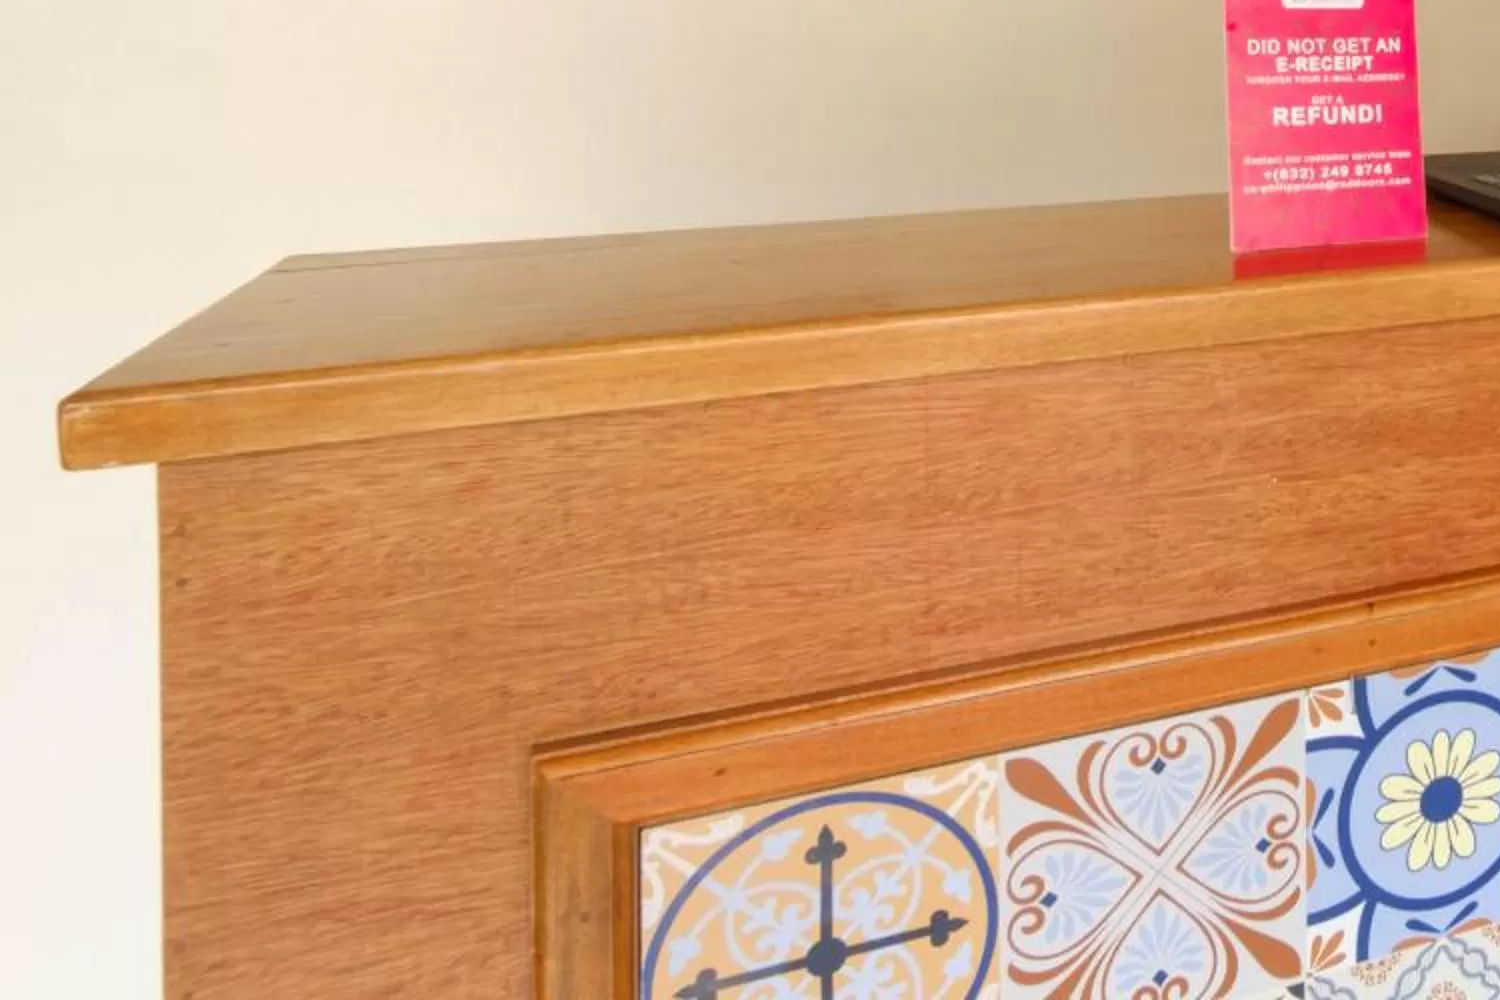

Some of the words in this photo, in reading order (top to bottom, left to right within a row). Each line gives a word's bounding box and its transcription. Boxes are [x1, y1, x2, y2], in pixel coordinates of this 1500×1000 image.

[1247, 39, 1280, 56] DID
[1287, 38, 1326, 55] NOT
[1332, 37, 1370, 54] GET
[1375, 36, 1401, 53] AN
[1275, 55, 1374, 73] E-RECEIPT
[1311, 96, 1333, 105] GET
[1335, 95, 1344, 105] A
[1272, 104, 1383, 127] REFUND!
